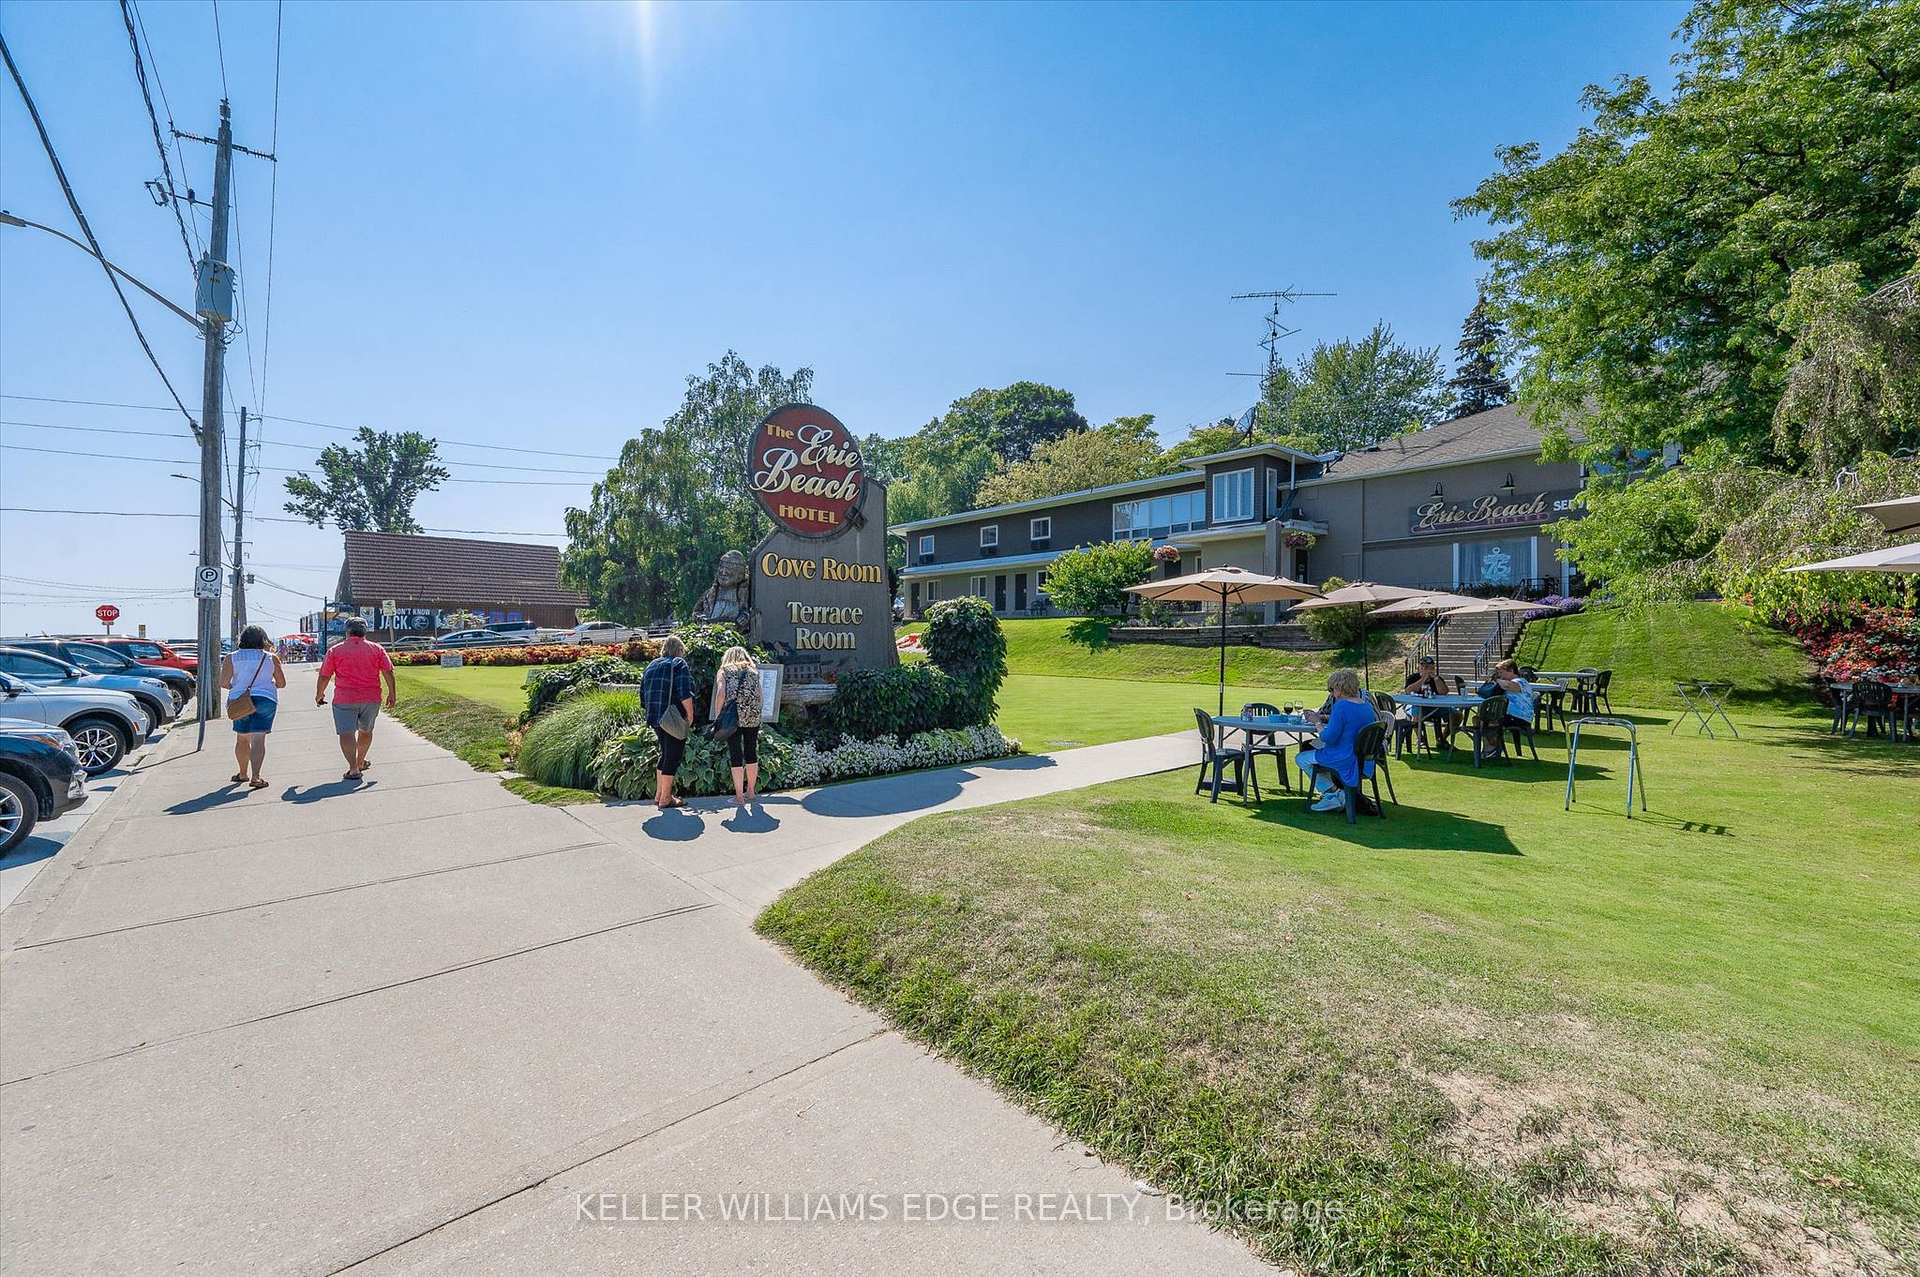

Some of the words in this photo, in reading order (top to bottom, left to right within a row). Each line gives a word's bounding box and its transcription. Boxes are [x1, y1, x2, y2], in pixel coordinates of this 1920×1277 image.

[765, 423, 795, 440] The
[797, 424, 861, 473] Erie
[749, 447, 860, 502] Beach
[779, 504, 840, 524] HOTEL
[1416, 501, 1466, 530] Erie
[1466, 492, 1550, 522] Beach
[761, 552, 816, 580] Cove
[822, 557, 882, 584] Room
[97, 609, 118, 617] STOP
[379, 615, 412, 630] JACK.
[413, 608, 430, 616] KNOW
[787, 601, 863, 625] Terrace
[795, 627, 856, 650] Room
